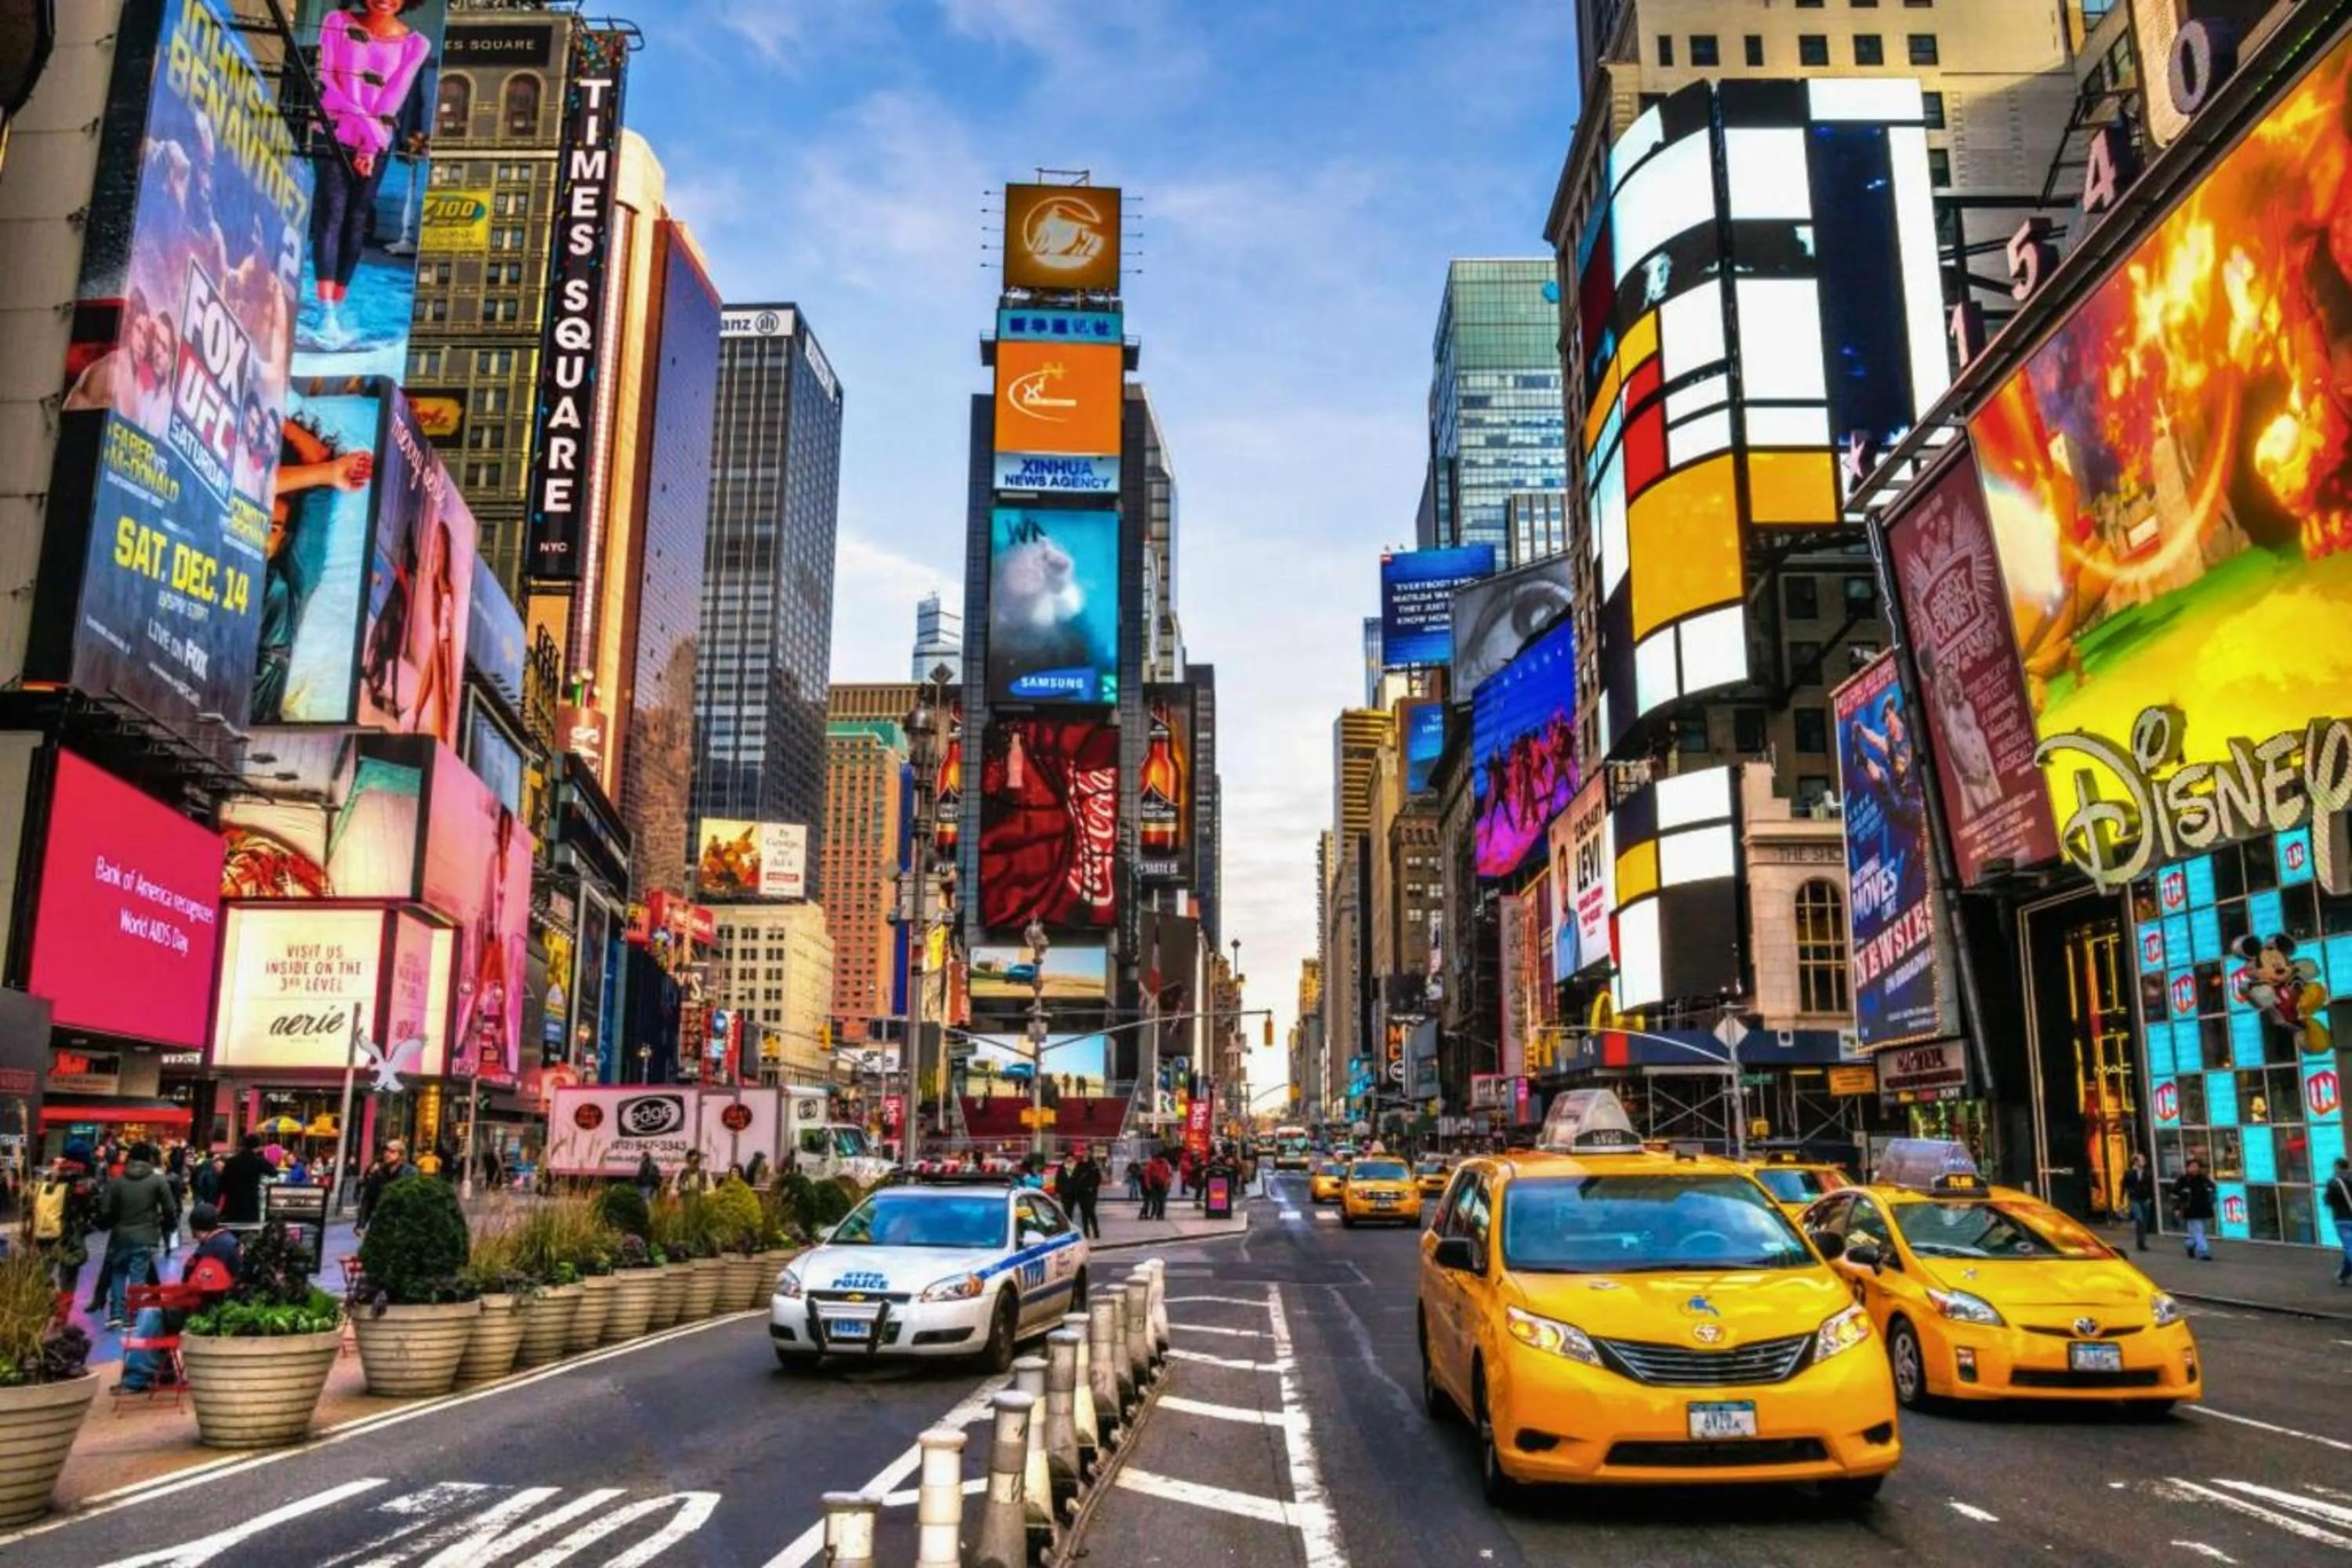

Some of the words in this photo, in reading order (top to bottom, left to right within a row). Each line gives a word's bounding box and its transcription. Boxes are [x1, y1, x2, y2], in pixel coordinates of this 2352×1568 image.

[470, 39, 535, 50] SQUARE
[184, 272, 249, 408] FOX
[177, 359, 236, 457] UFC
[171, 416, 230, 497] SATURDAY
[1021, 458, 1094, 476] XINHUA
[1005, 474, 1047, 487] NEWS
[1050, 475, 1111, 488] AGENCY
[539, 543, 568, 553] NYC
[223, 567, 249, 615] 14
[1021, 677, 1084, 688] SAMSUNG
[1576, 832, 1602, 894] LEVI
[96, 855, 120, 887] Bank
[122, 869, 136, 891] of
[136, 874, 172, 907] America
[1852, 869, 1898, 925] MOVES
[120, 907, 149, 938] World
[149, 920, 171, 947] AIDS
[172, 927, 189, 957] Day
[287, 943, 322, 959] VISIT
[327, 944, 345, 959] US
[266, 961, 310, 975] INSIDE
[314, 961, 333, 975] ON
[339, 961, 361, 975] THE
[306, 978, 344, 993] LEVEL
[270, 1005, 346, 1036] aerie
[831, 1279, 890, 1290] POLICE
